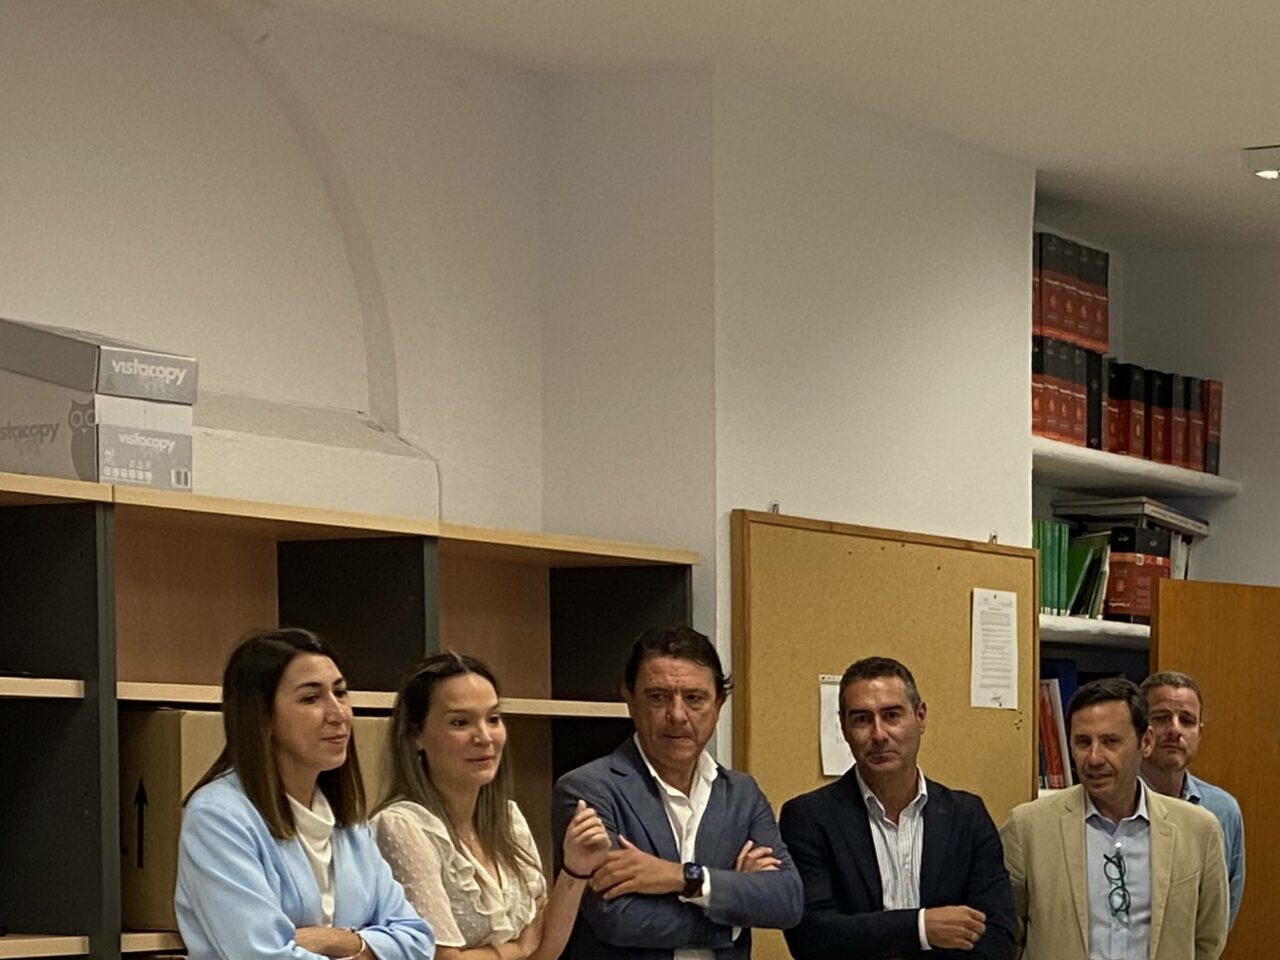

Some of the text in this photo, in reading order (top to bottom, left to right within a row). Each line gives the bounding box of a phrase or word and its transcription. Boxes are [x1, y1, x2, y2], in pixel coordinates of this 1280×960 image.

[112, 358, 187, 385] vistacopy
[0, 421, 60, 443] stacopy
[118, 433, 176, 453] vistacopy
